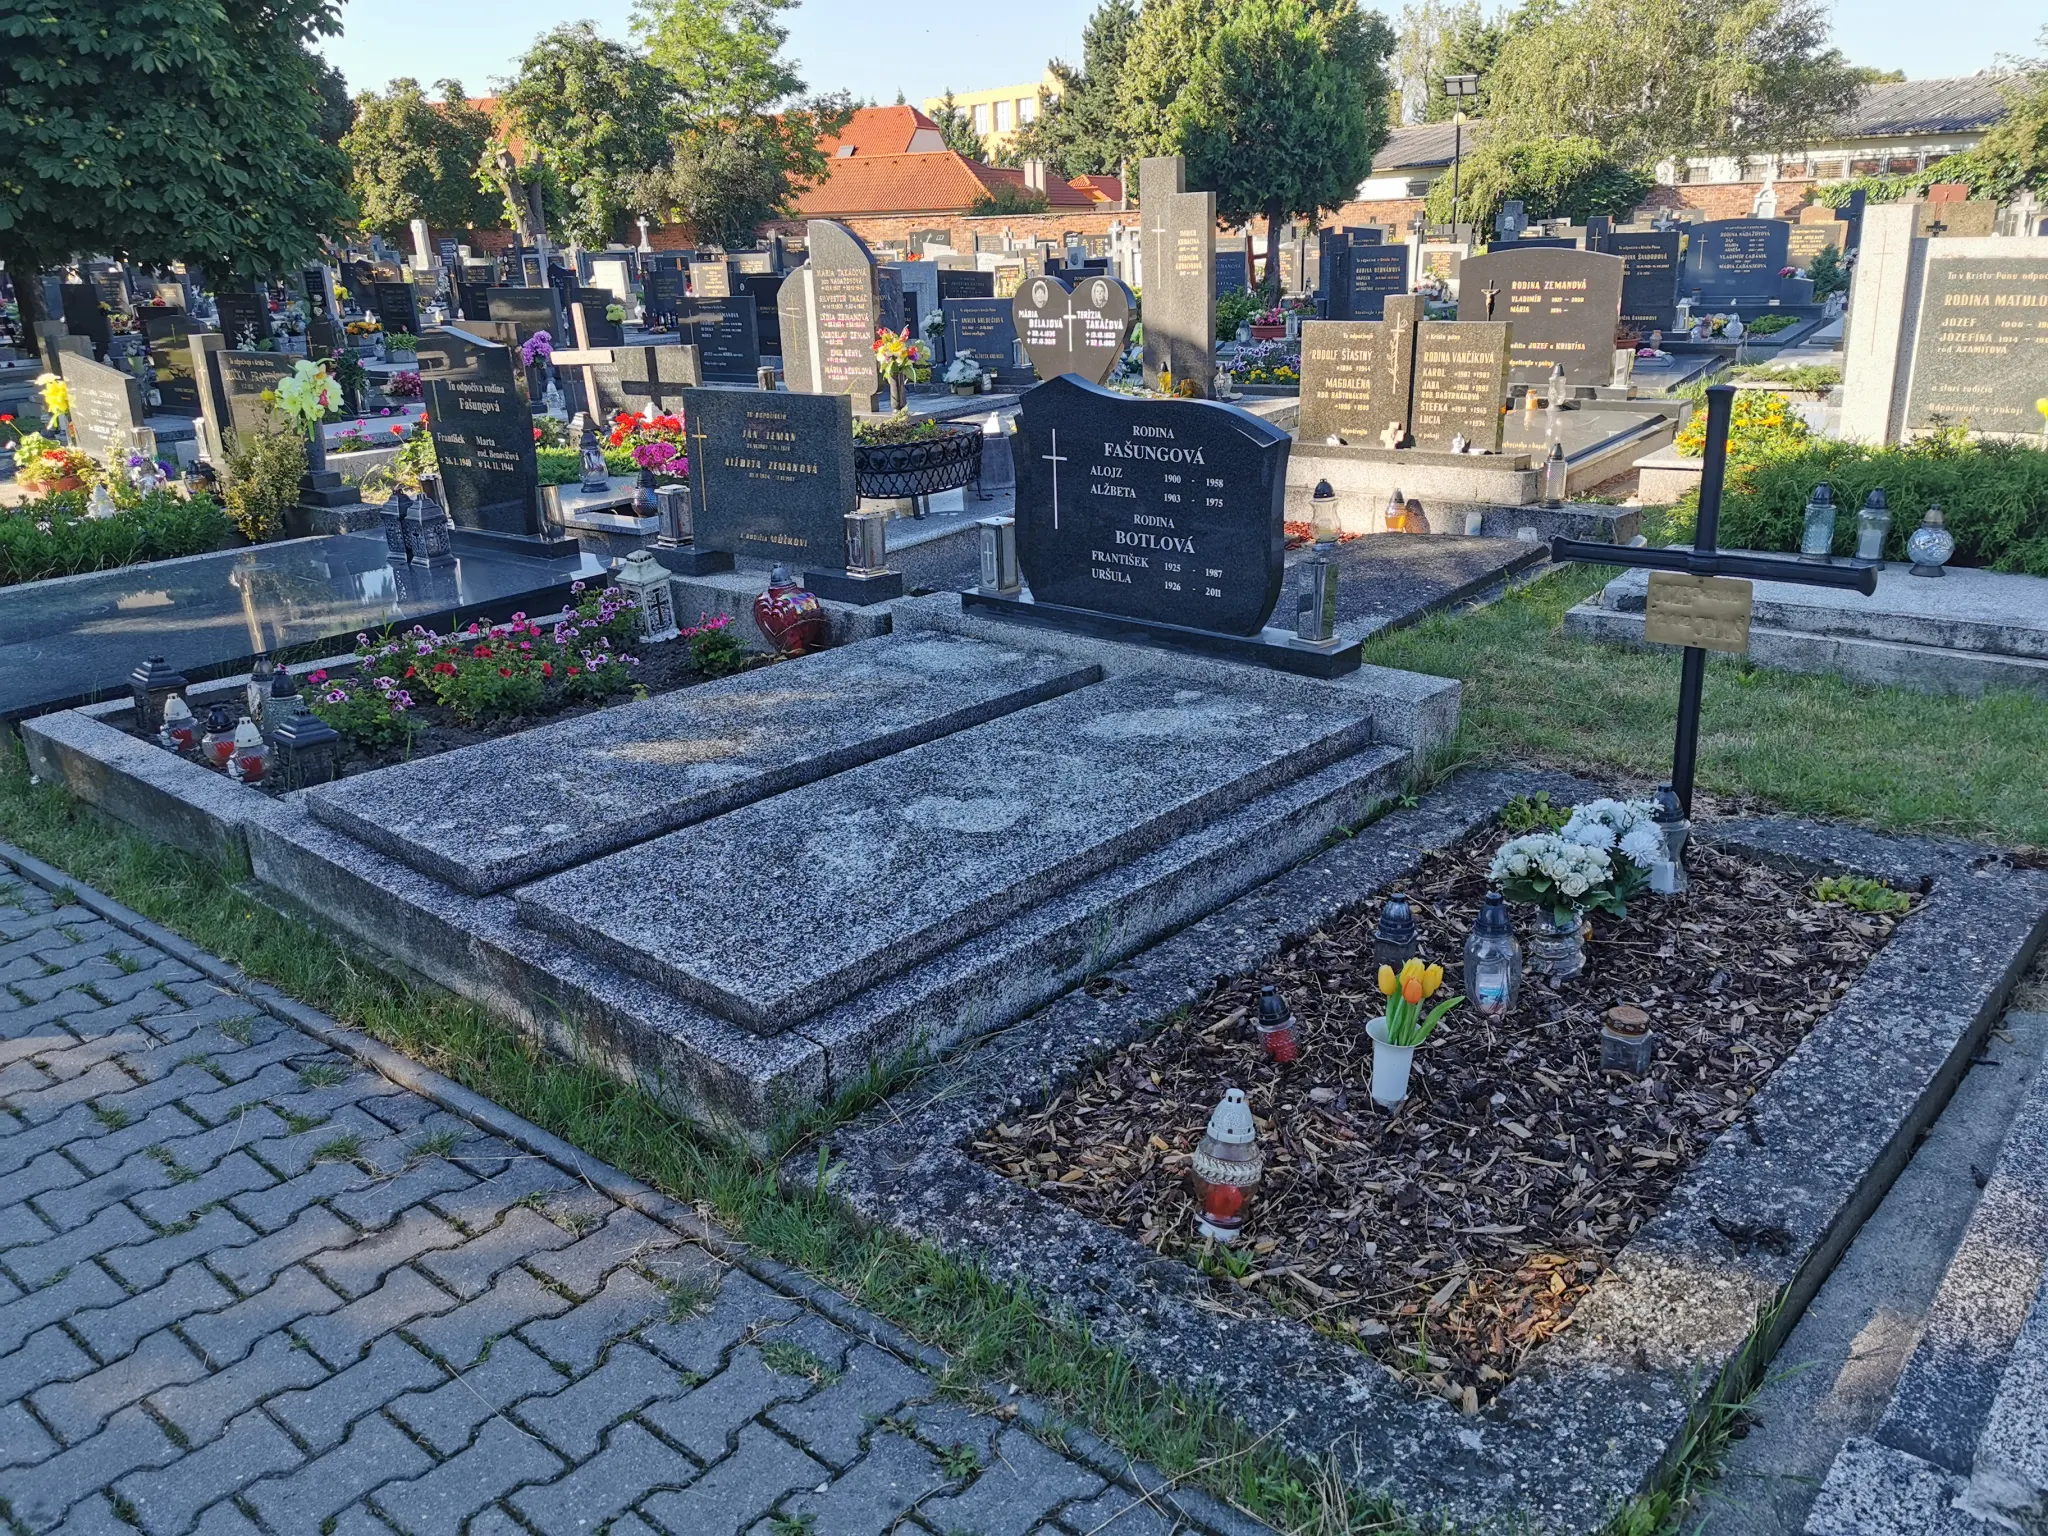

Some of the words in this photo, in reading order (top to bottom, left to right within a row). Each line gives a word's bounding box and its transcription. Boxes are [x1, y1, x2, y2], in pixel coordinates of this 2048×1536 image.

[1948, 272, 1958, 280] Tu
[1511, 281, 1541, 290] RODINA
[1544, 278, 1588, 290] ZEMANOVÁ
[1511, 294, 1543, 303] VLADIMÍR
[1943, 294, 1990, 307] RODINA
[1018, 308, 1040, 319] MÁRIA
[1509, 305, 1531, 313] MÁRIA
[1941, 318, 1977, 328] JOZEF
[1939, 331, 1993, 342] JOZEFÍNA
[1311, 350, 1338, 361] RUDOLF
[1424, 351, 1450, 364] RODINA
[1452, 349, 1495, 364] VANČÍKOVÁ
[1422, 367, 1446, 378] KAROL
[448, 382, 456, 391] Tu
[456, 382, 484, 394] odpočíva
[484, 384, 505, 394] rodina
[458, 397, 500, 414] Fašungová
[1419, 415, 1441, 425] LUCIA
[437, 432, 466, 444] František
[766, 431, 797, 442] ZEMAN
[1132, 425, 1175, 439] RODINA
[475, 436, 496, 447] Marta
[1104, 440, 1206, 465] FAŠUNGOVÁ
[724, 456, 762, 469] ALŽBETA
[768, 460, 819, 475] ZEMANOVÁ
[1090, 465, 1123, 478] ALOJZ
[1164, 474, 1181, 484] 1900
[1206, 478, 1224, 488] 1958
[1090, 483, 1136, 498] ALŽBETA
[1164, 493, 1181, 503] 1903
[1205, 497, 1224, 508] 1975
[1133, 514, 1175, 529] RODINA
[1115, 530, 1196, 554] BOTLOVÁ
[1091, 550, 1149, 568] FRANTIŠEK
[1164, 562, 1181, 573] 1925
[1205, 568, 1223, 578] 1987
[1091, 567, 1132, 584] URŠULA
[1164, 581, 1181, 591] 1926
[1205, 587, 1222, 597] 2011
